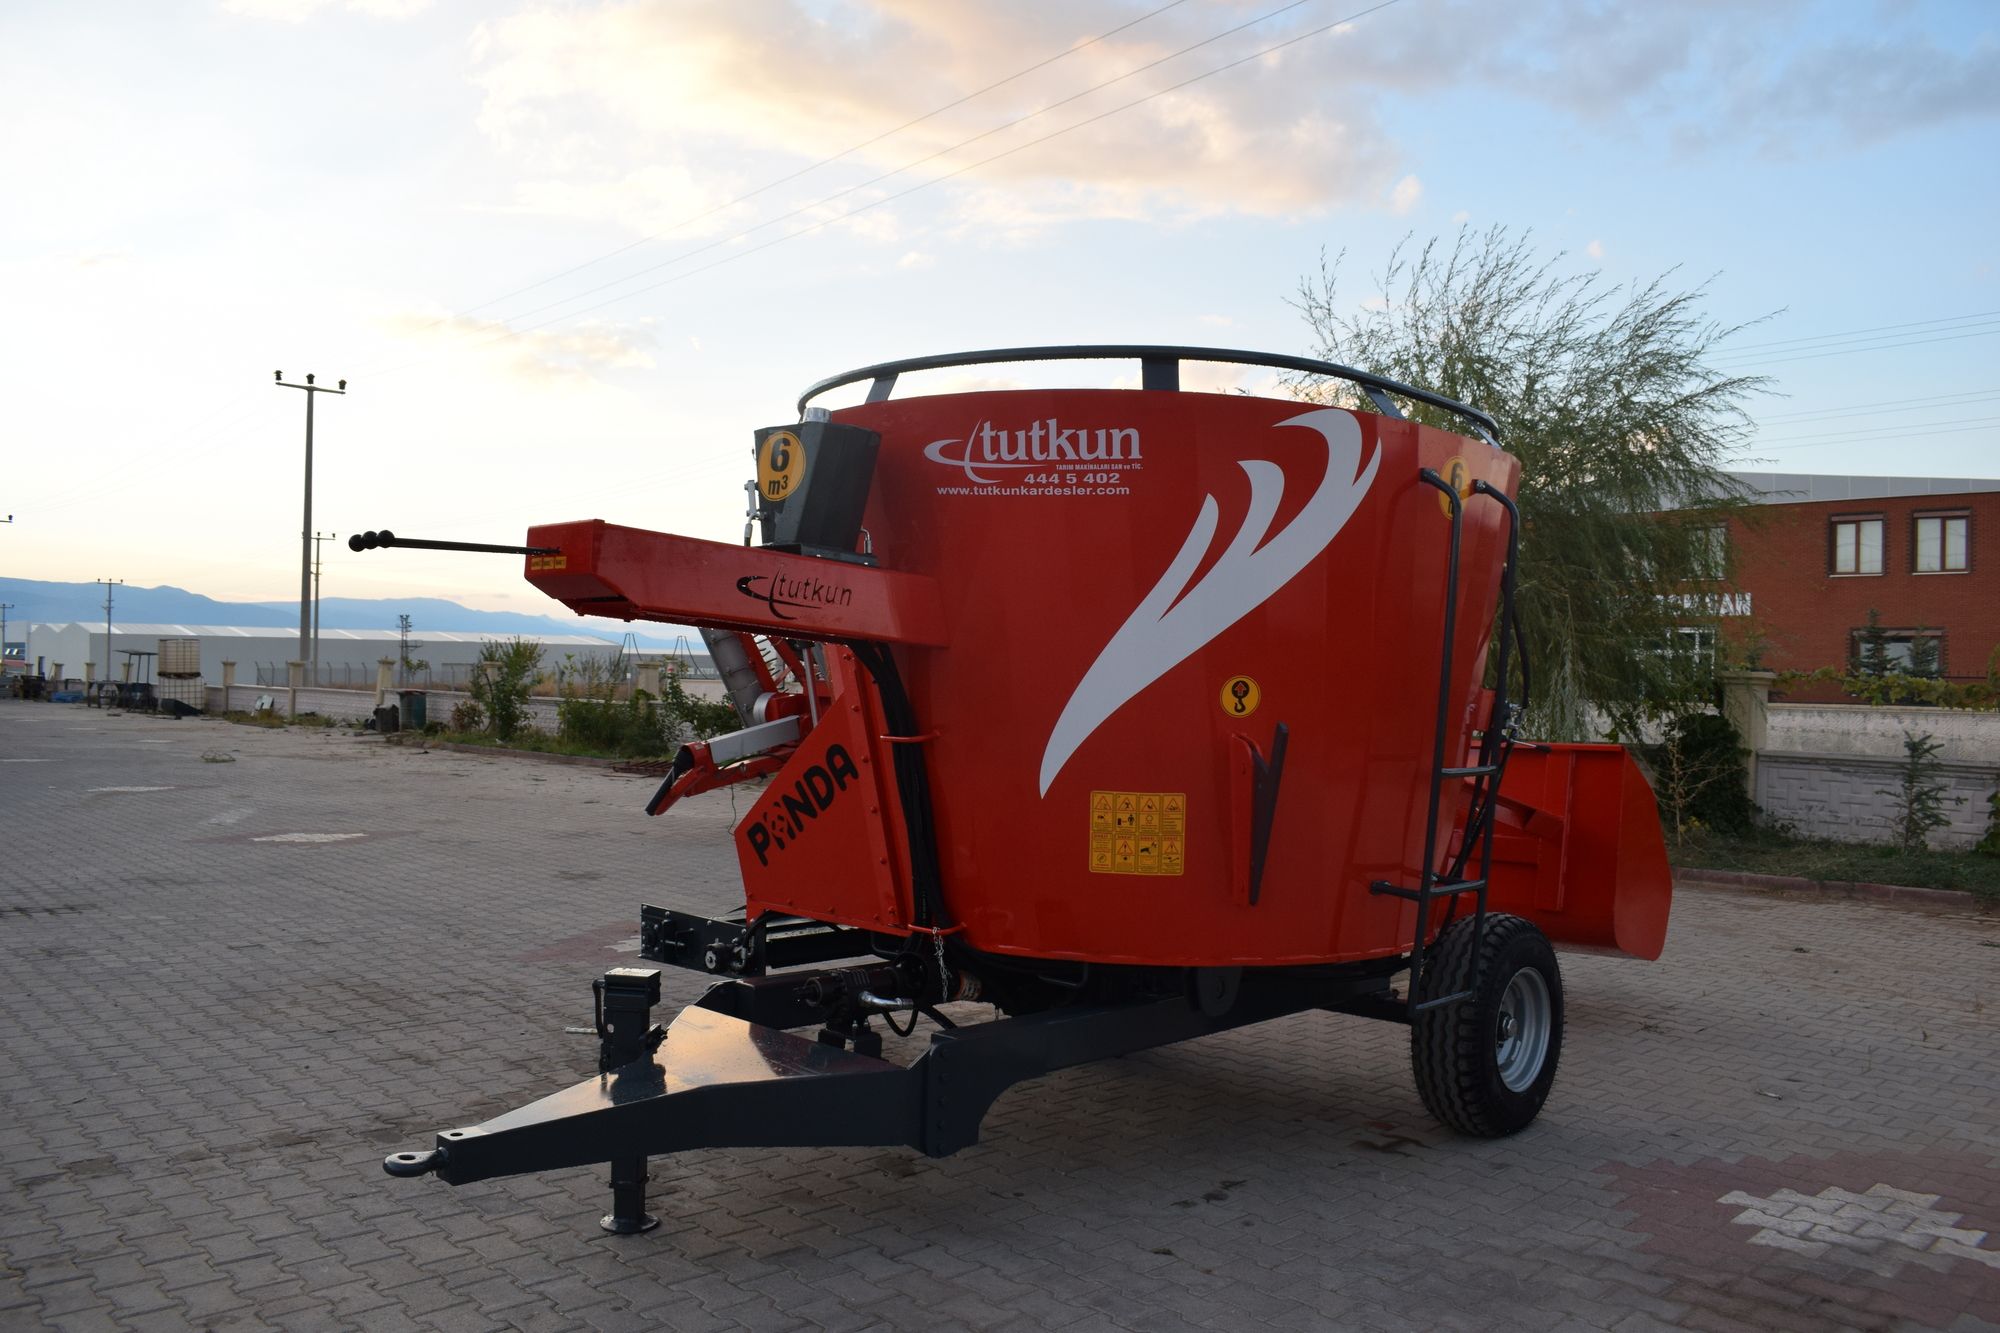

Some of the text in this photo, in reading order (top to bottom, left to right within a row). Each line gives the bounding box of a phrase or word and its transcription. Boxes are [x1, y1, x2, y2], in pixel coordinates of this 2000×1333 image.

[771, 438, 791, 472] 6
[979, 418, 1143, 461] tutkun
[937, 485, 1130, 496] www.tutkunkardesler.com
[1024, 473, 1120, 484] 444 5 402
[1452, 462, 1464, 494] 6
[778, 574, 853, 607] tutkun
